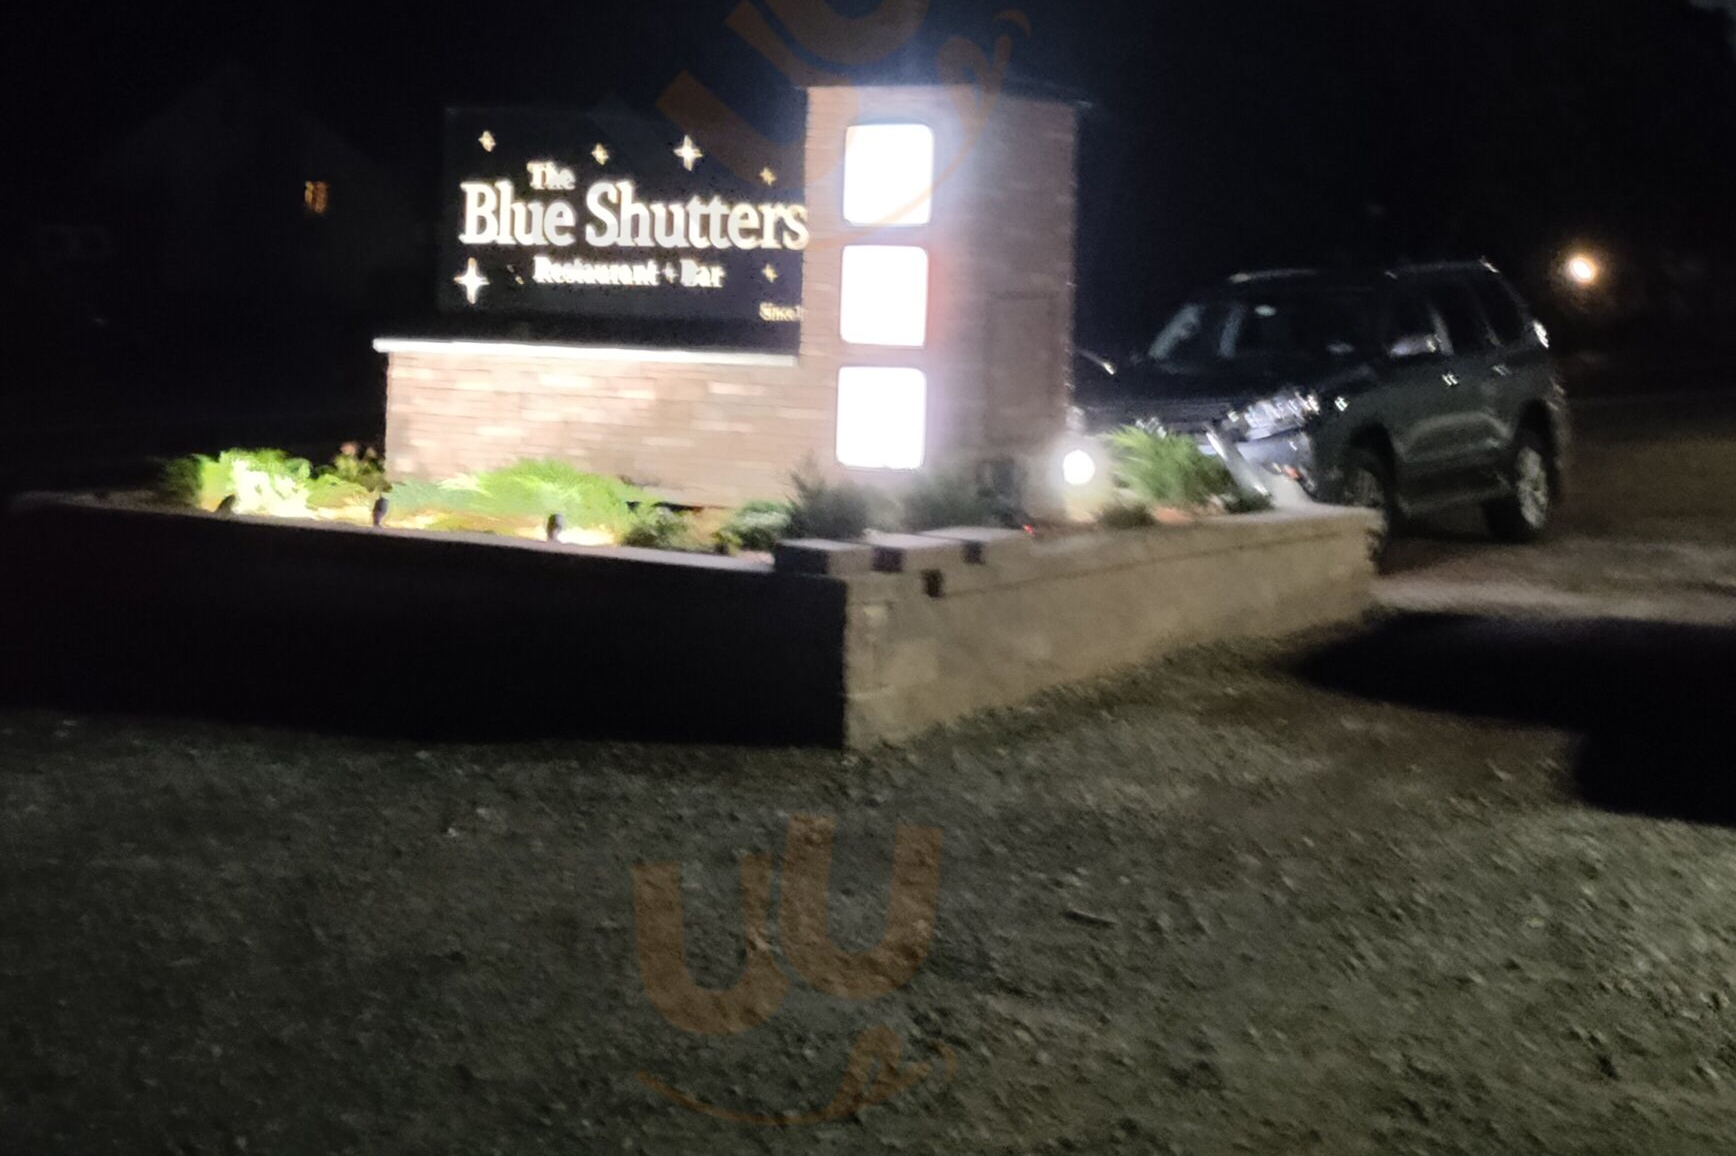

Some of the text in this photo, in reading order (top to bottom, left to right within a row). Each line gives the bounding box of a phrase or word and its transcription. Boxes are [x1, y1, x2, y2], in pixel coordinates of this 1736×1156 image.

[526, 160, 576, 191] The
[458, 180, 811, 250] Blue Shutters
[533, 255, 727, 288] Restaurant Bar
